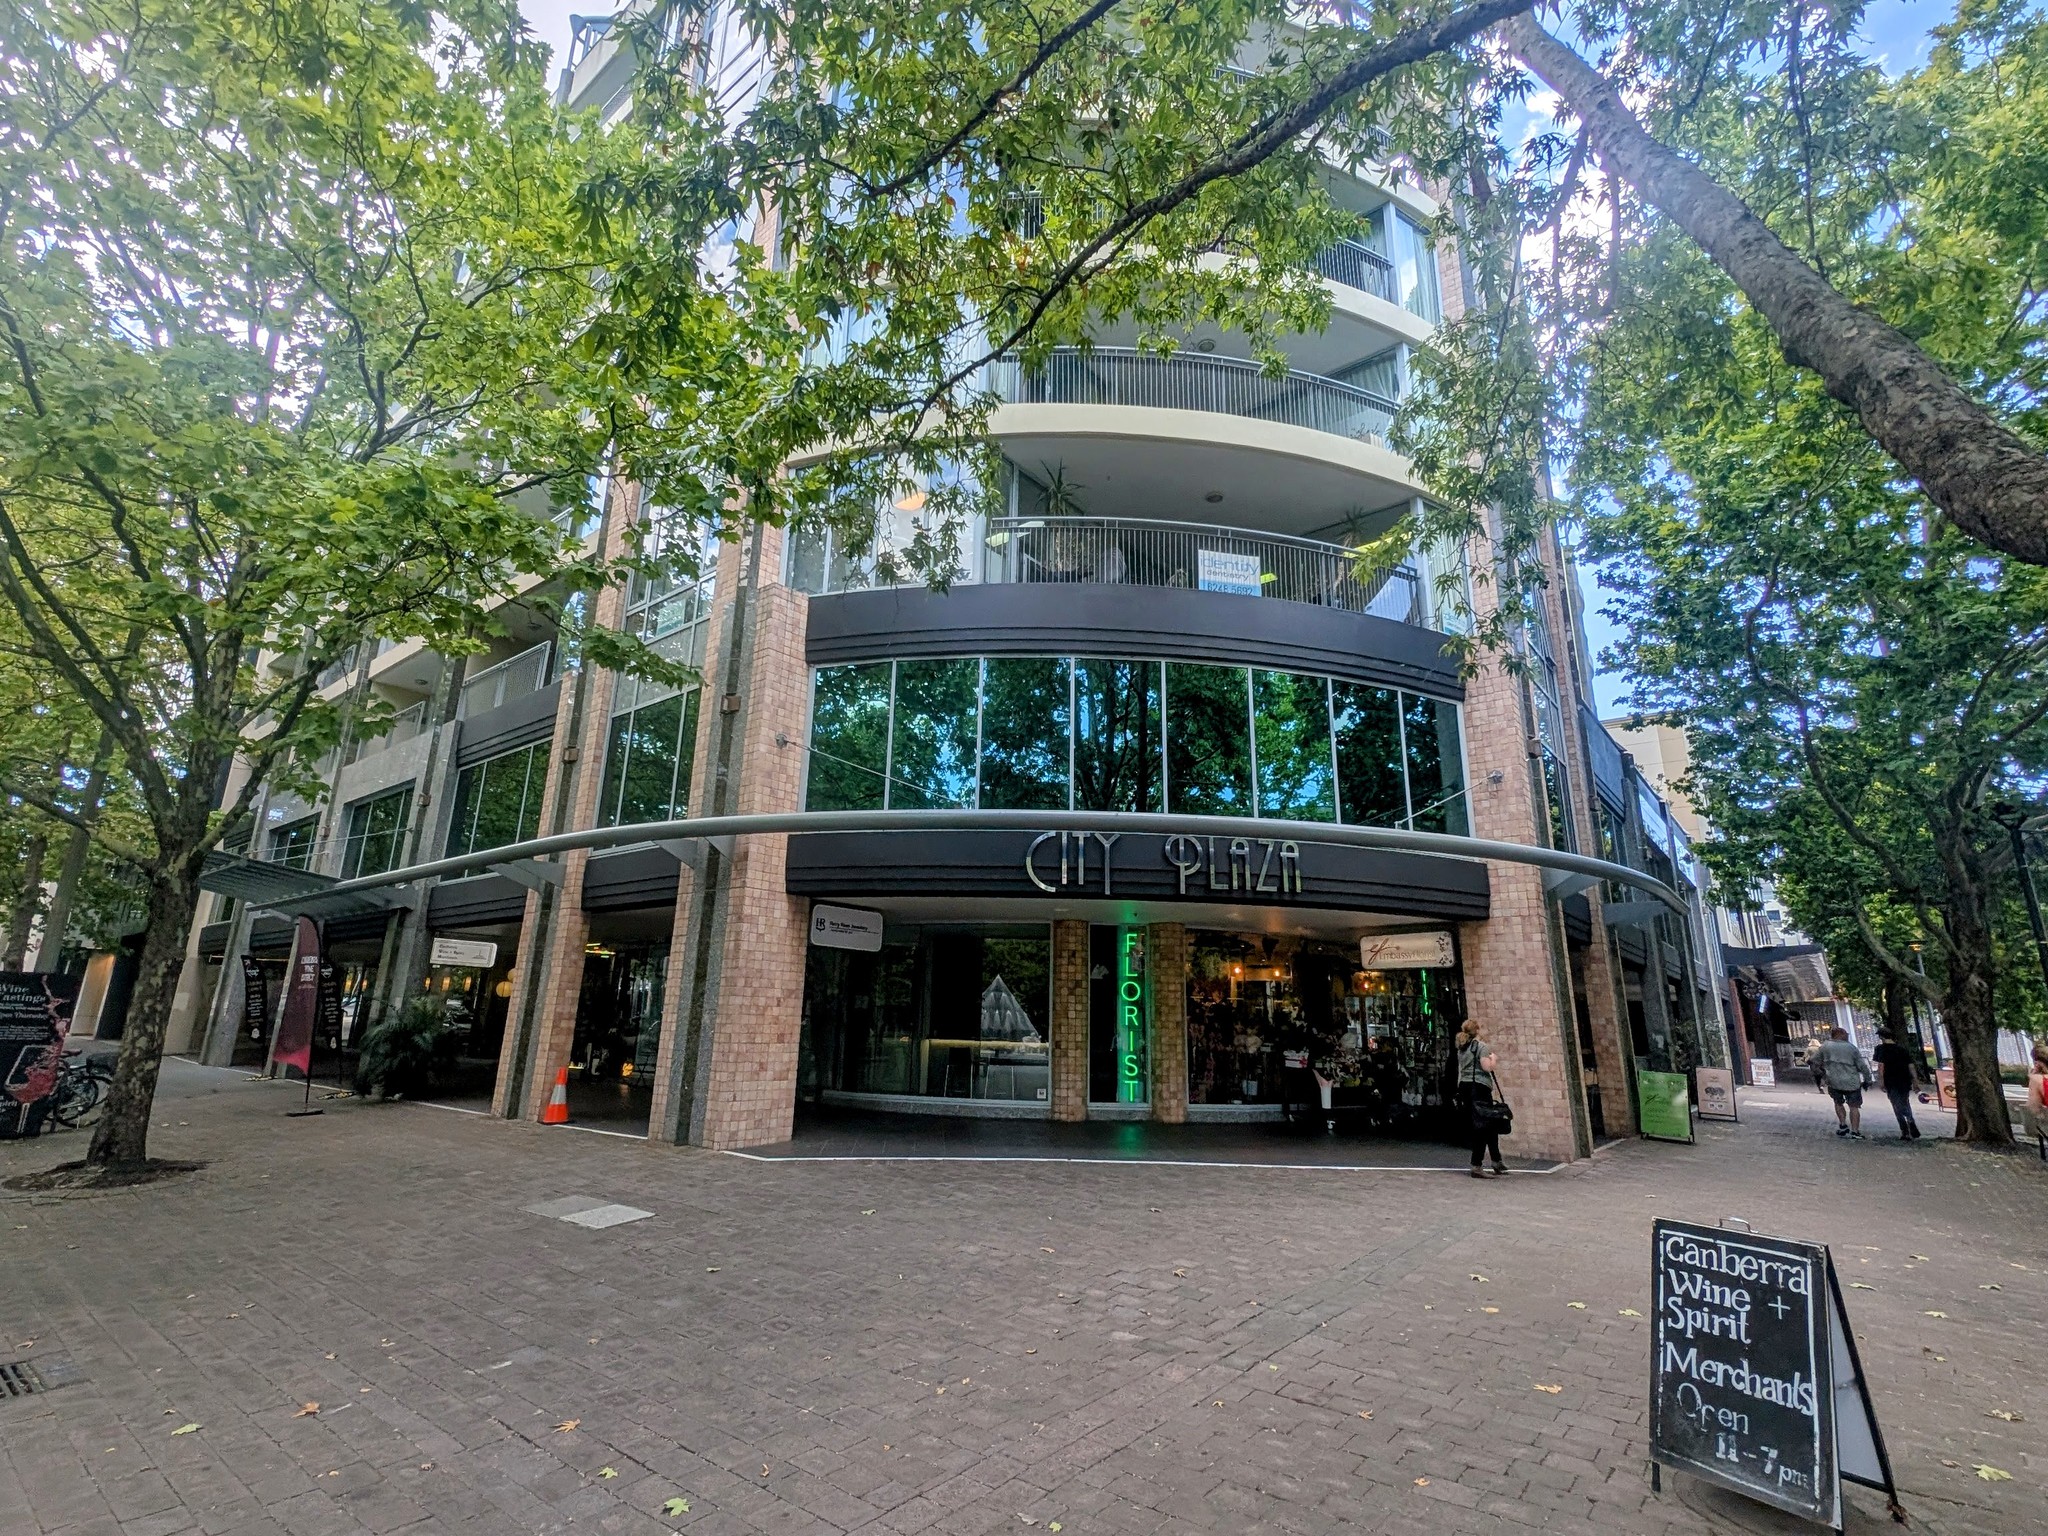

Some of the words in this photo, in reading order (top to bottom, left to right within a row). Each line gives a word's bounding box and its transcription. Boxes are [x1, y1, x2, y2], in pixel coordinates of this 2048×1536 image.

[1207, 569, 1249, 581] dentistry
[1026, 831, 1120, 895] CITY
[1165, 835, 1302, 895] PLAZA
[0, 991, 46, 1004] astings
[1121, 934, 1140, 1102] FLORIST
[1666, 1236, 1809, 1295] Canberra
[1668, 1269, 1751, 1312] Wine
[1667, 1297, 1751, 1344] Spirit
[1665, 1341, 1815, 1416] Merchants
